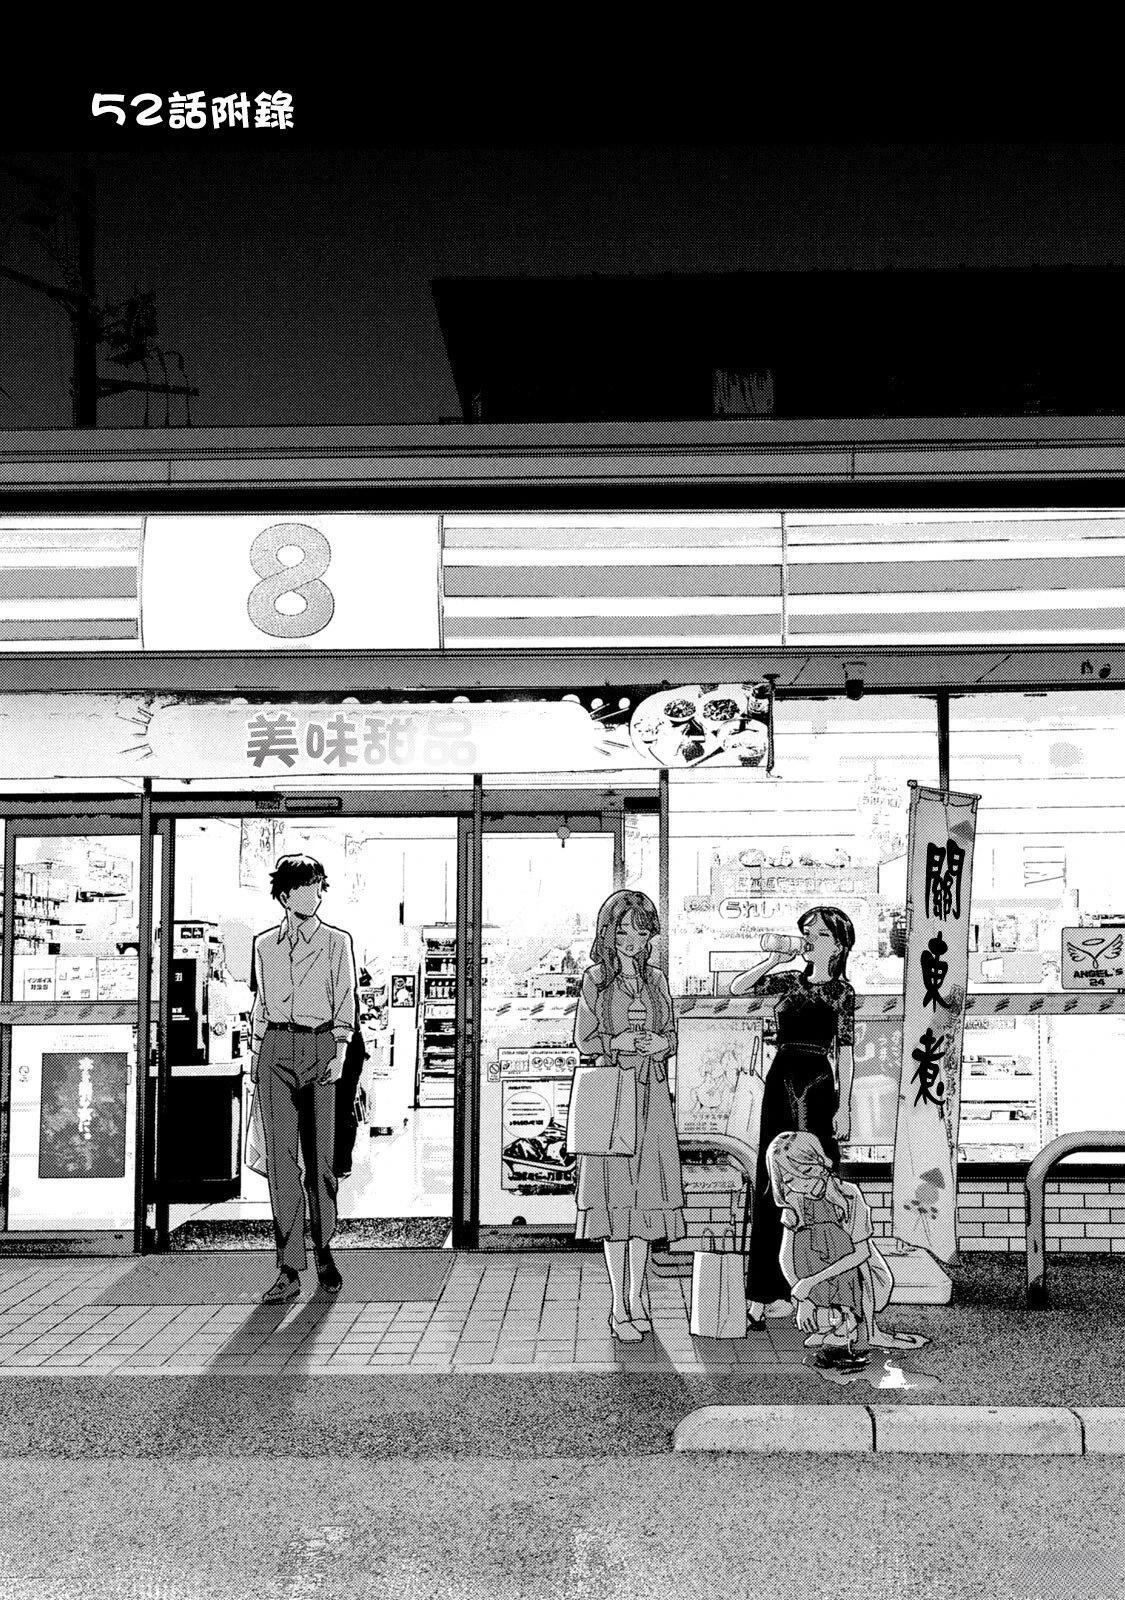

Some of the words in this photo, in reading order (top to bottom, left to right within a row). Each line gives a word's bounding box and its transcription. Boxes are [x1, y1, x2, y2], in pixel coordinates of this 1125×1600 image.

[247, 522, 335, 639] 8
[246, 712, 478, 768] 美味甜品
[1073, 968, 1124, 979] ANGEL'S
[1089, 978, 1106, 987] 24
